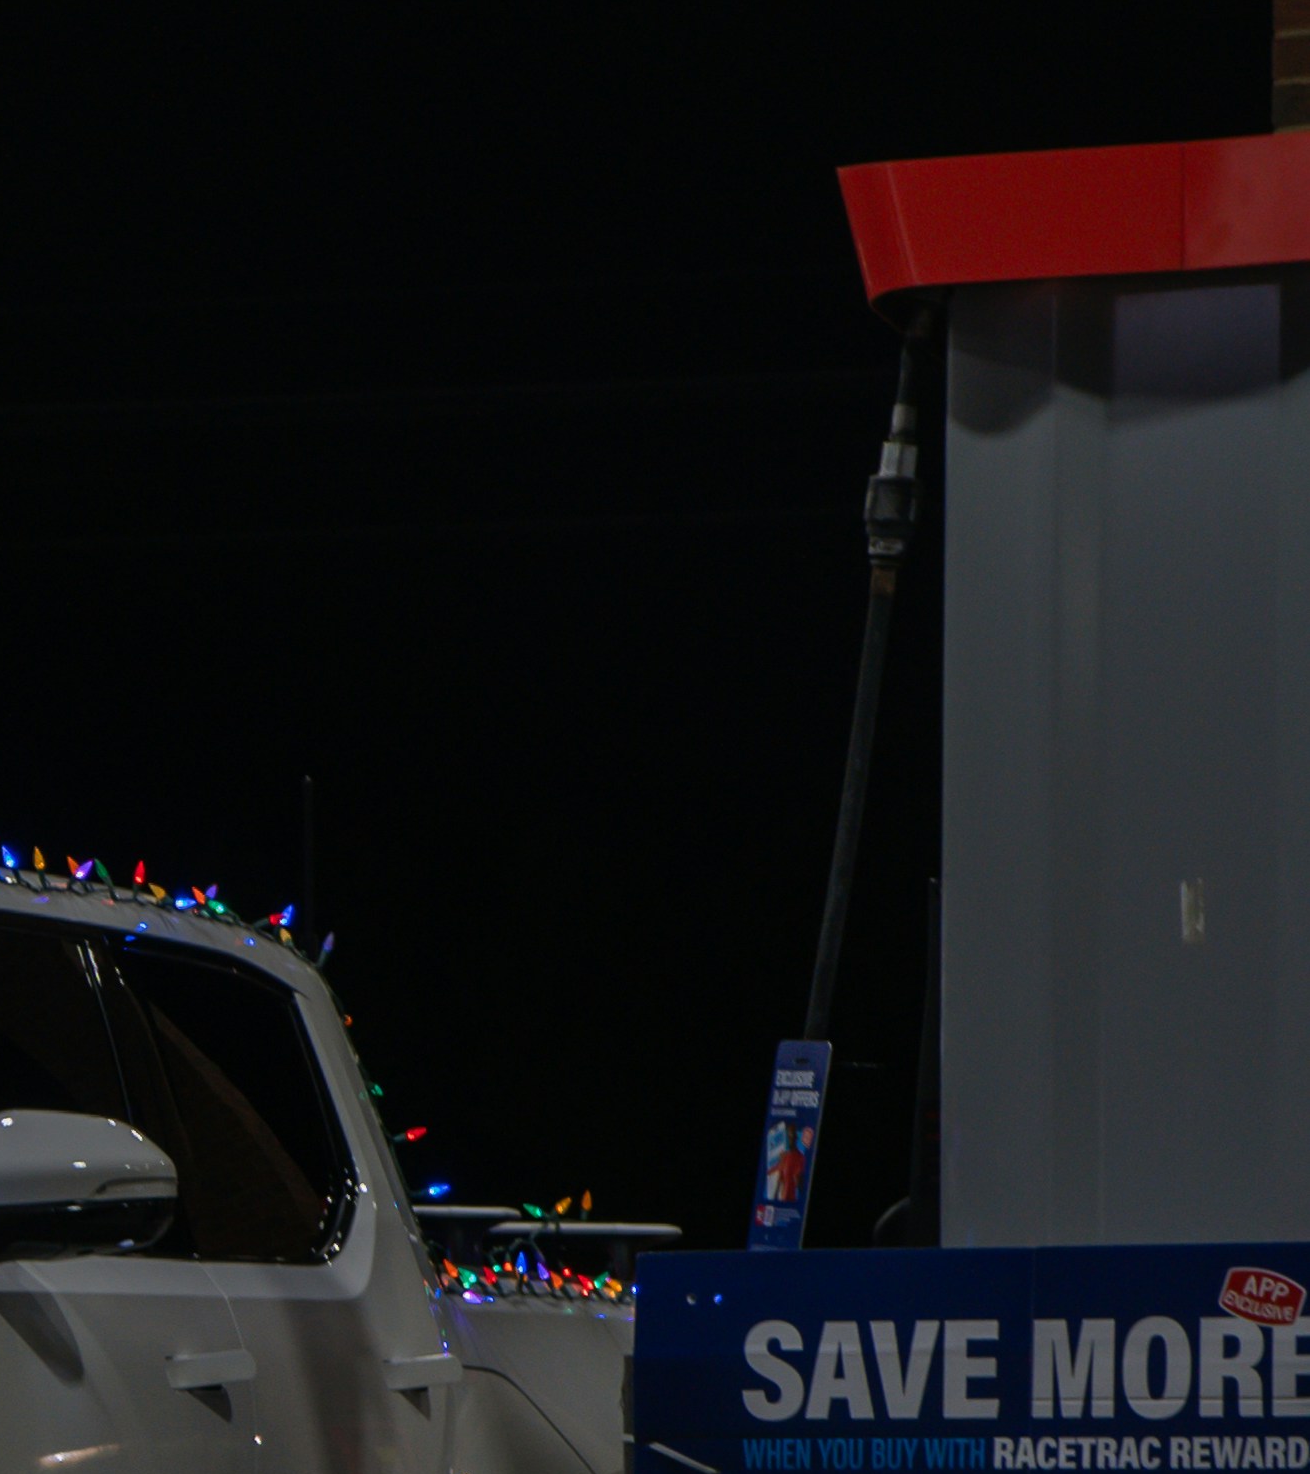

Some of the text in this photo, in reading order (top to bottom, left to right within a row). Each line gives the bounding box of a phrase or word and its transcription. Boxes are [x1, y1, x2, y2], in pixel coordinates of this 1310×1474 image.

[1242, 1274, 1290, 1303] APP
[1224, 1290, 1296, 1322] EXCLUSIVE
[741, 1315, 1310, 1422] SAVE MORE
[742, 1438, 812, 1470] WHEN
[816, 1438, 864, 1470] YOU
[870, 1438, 919, 1470] BUY
[923, 1438, 986, 1470] WITH
[992, 1436, 1162, 1470] RACETRAC
